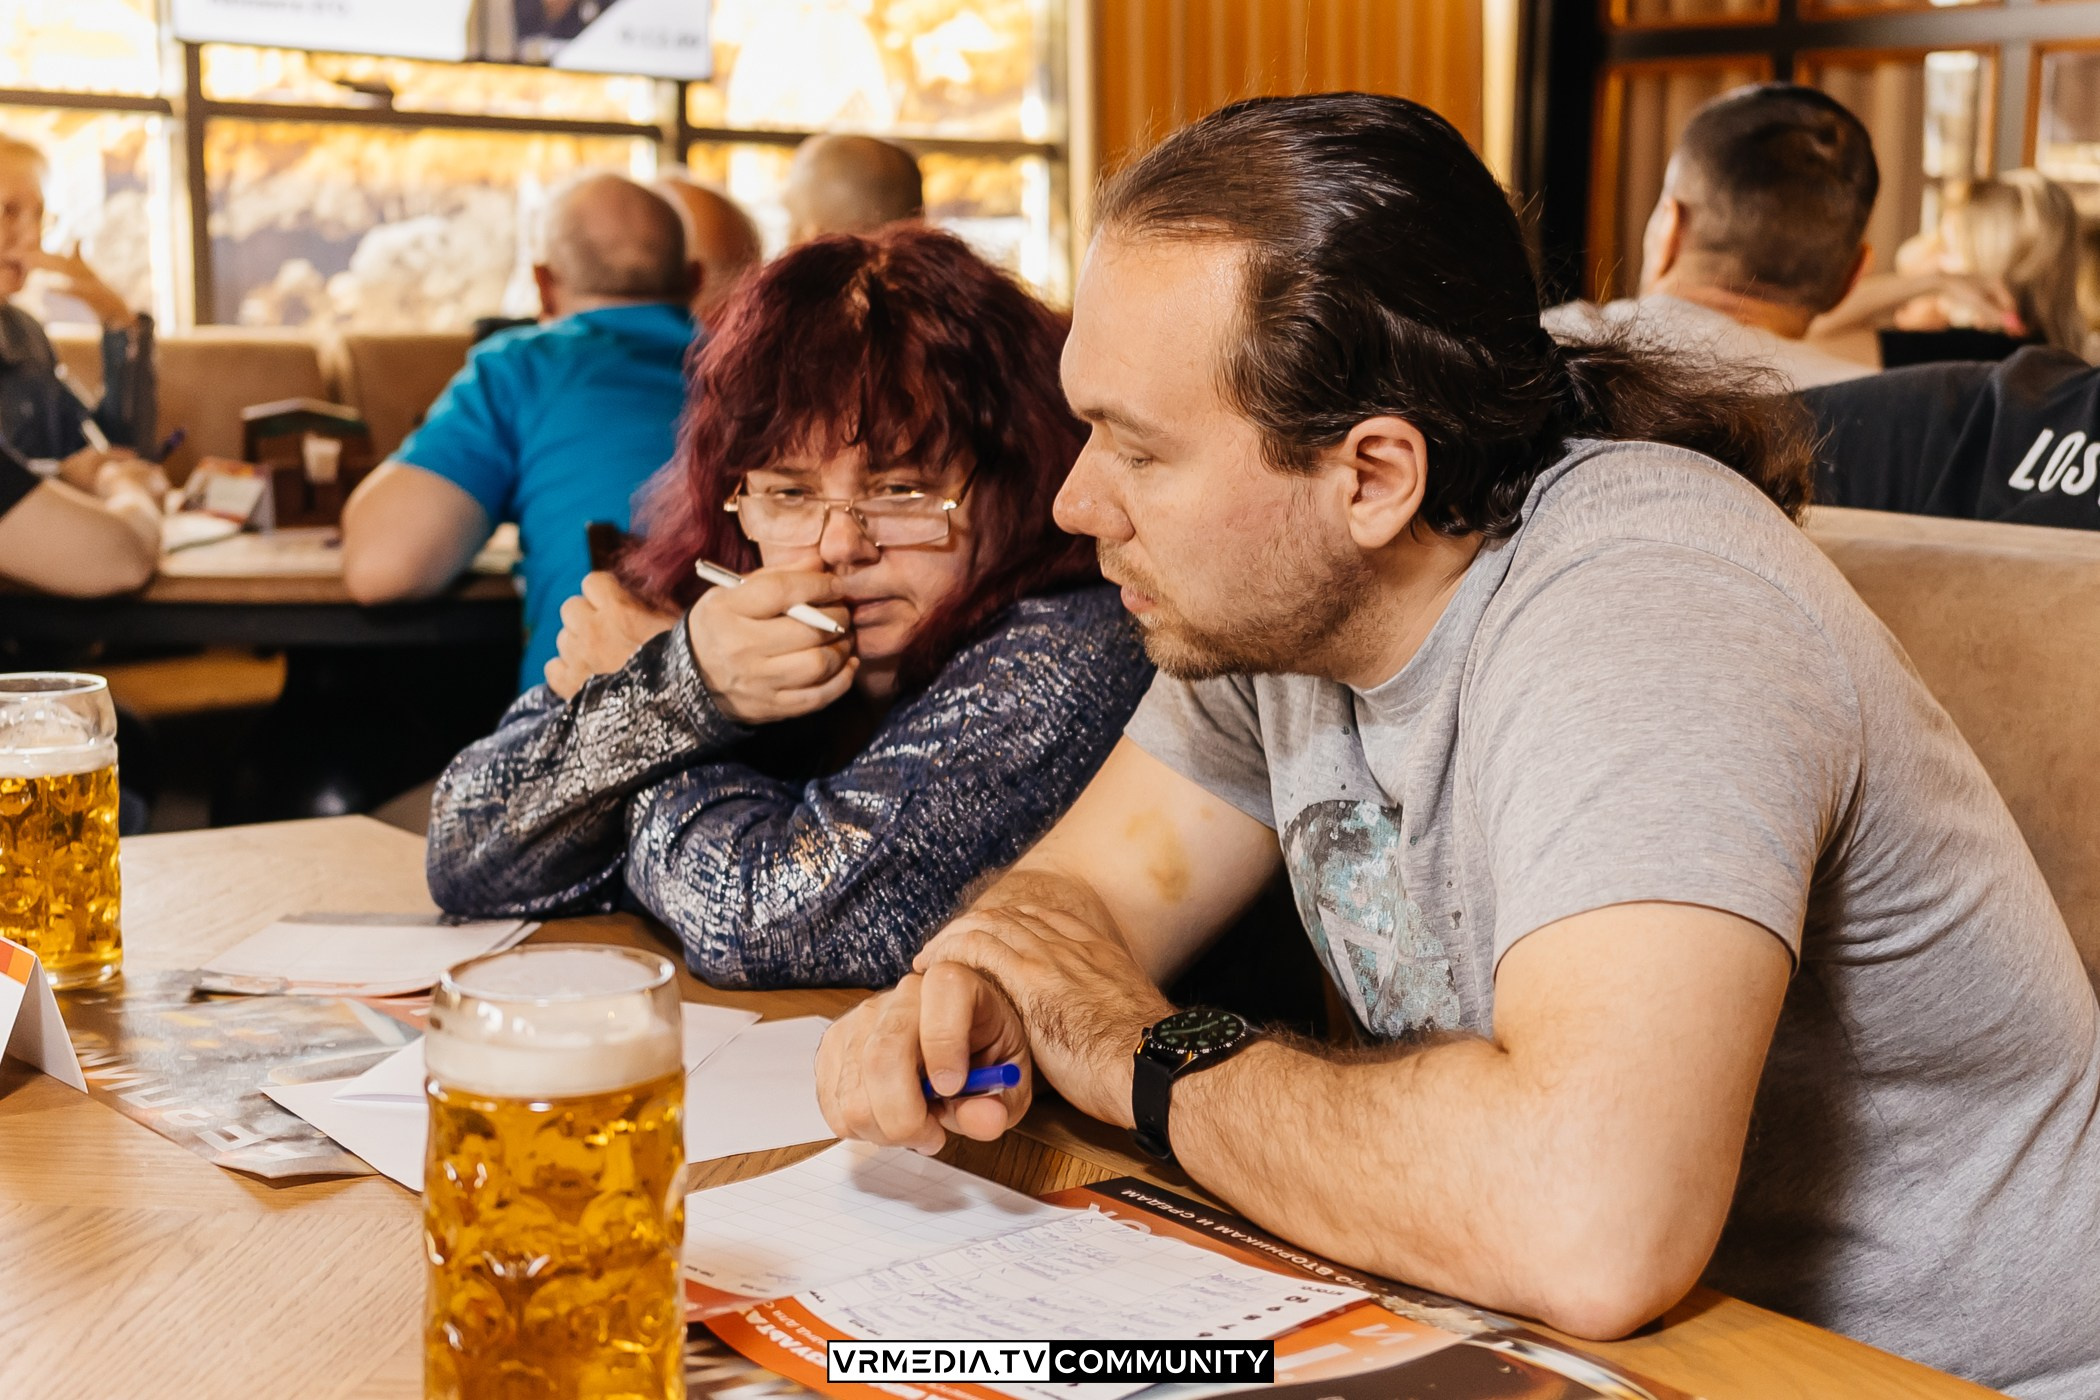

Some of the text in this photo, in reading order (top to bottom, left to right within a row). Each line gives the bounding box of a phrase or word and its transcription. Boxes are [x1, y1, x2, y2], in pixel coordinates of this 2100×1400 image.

[1121, 1190, 1196, 1219] СРЕДАМ
[1196, 1218, 1215, 1227] И
[1213, 1225, 1335, 1276] ВТОРНИКАМ
